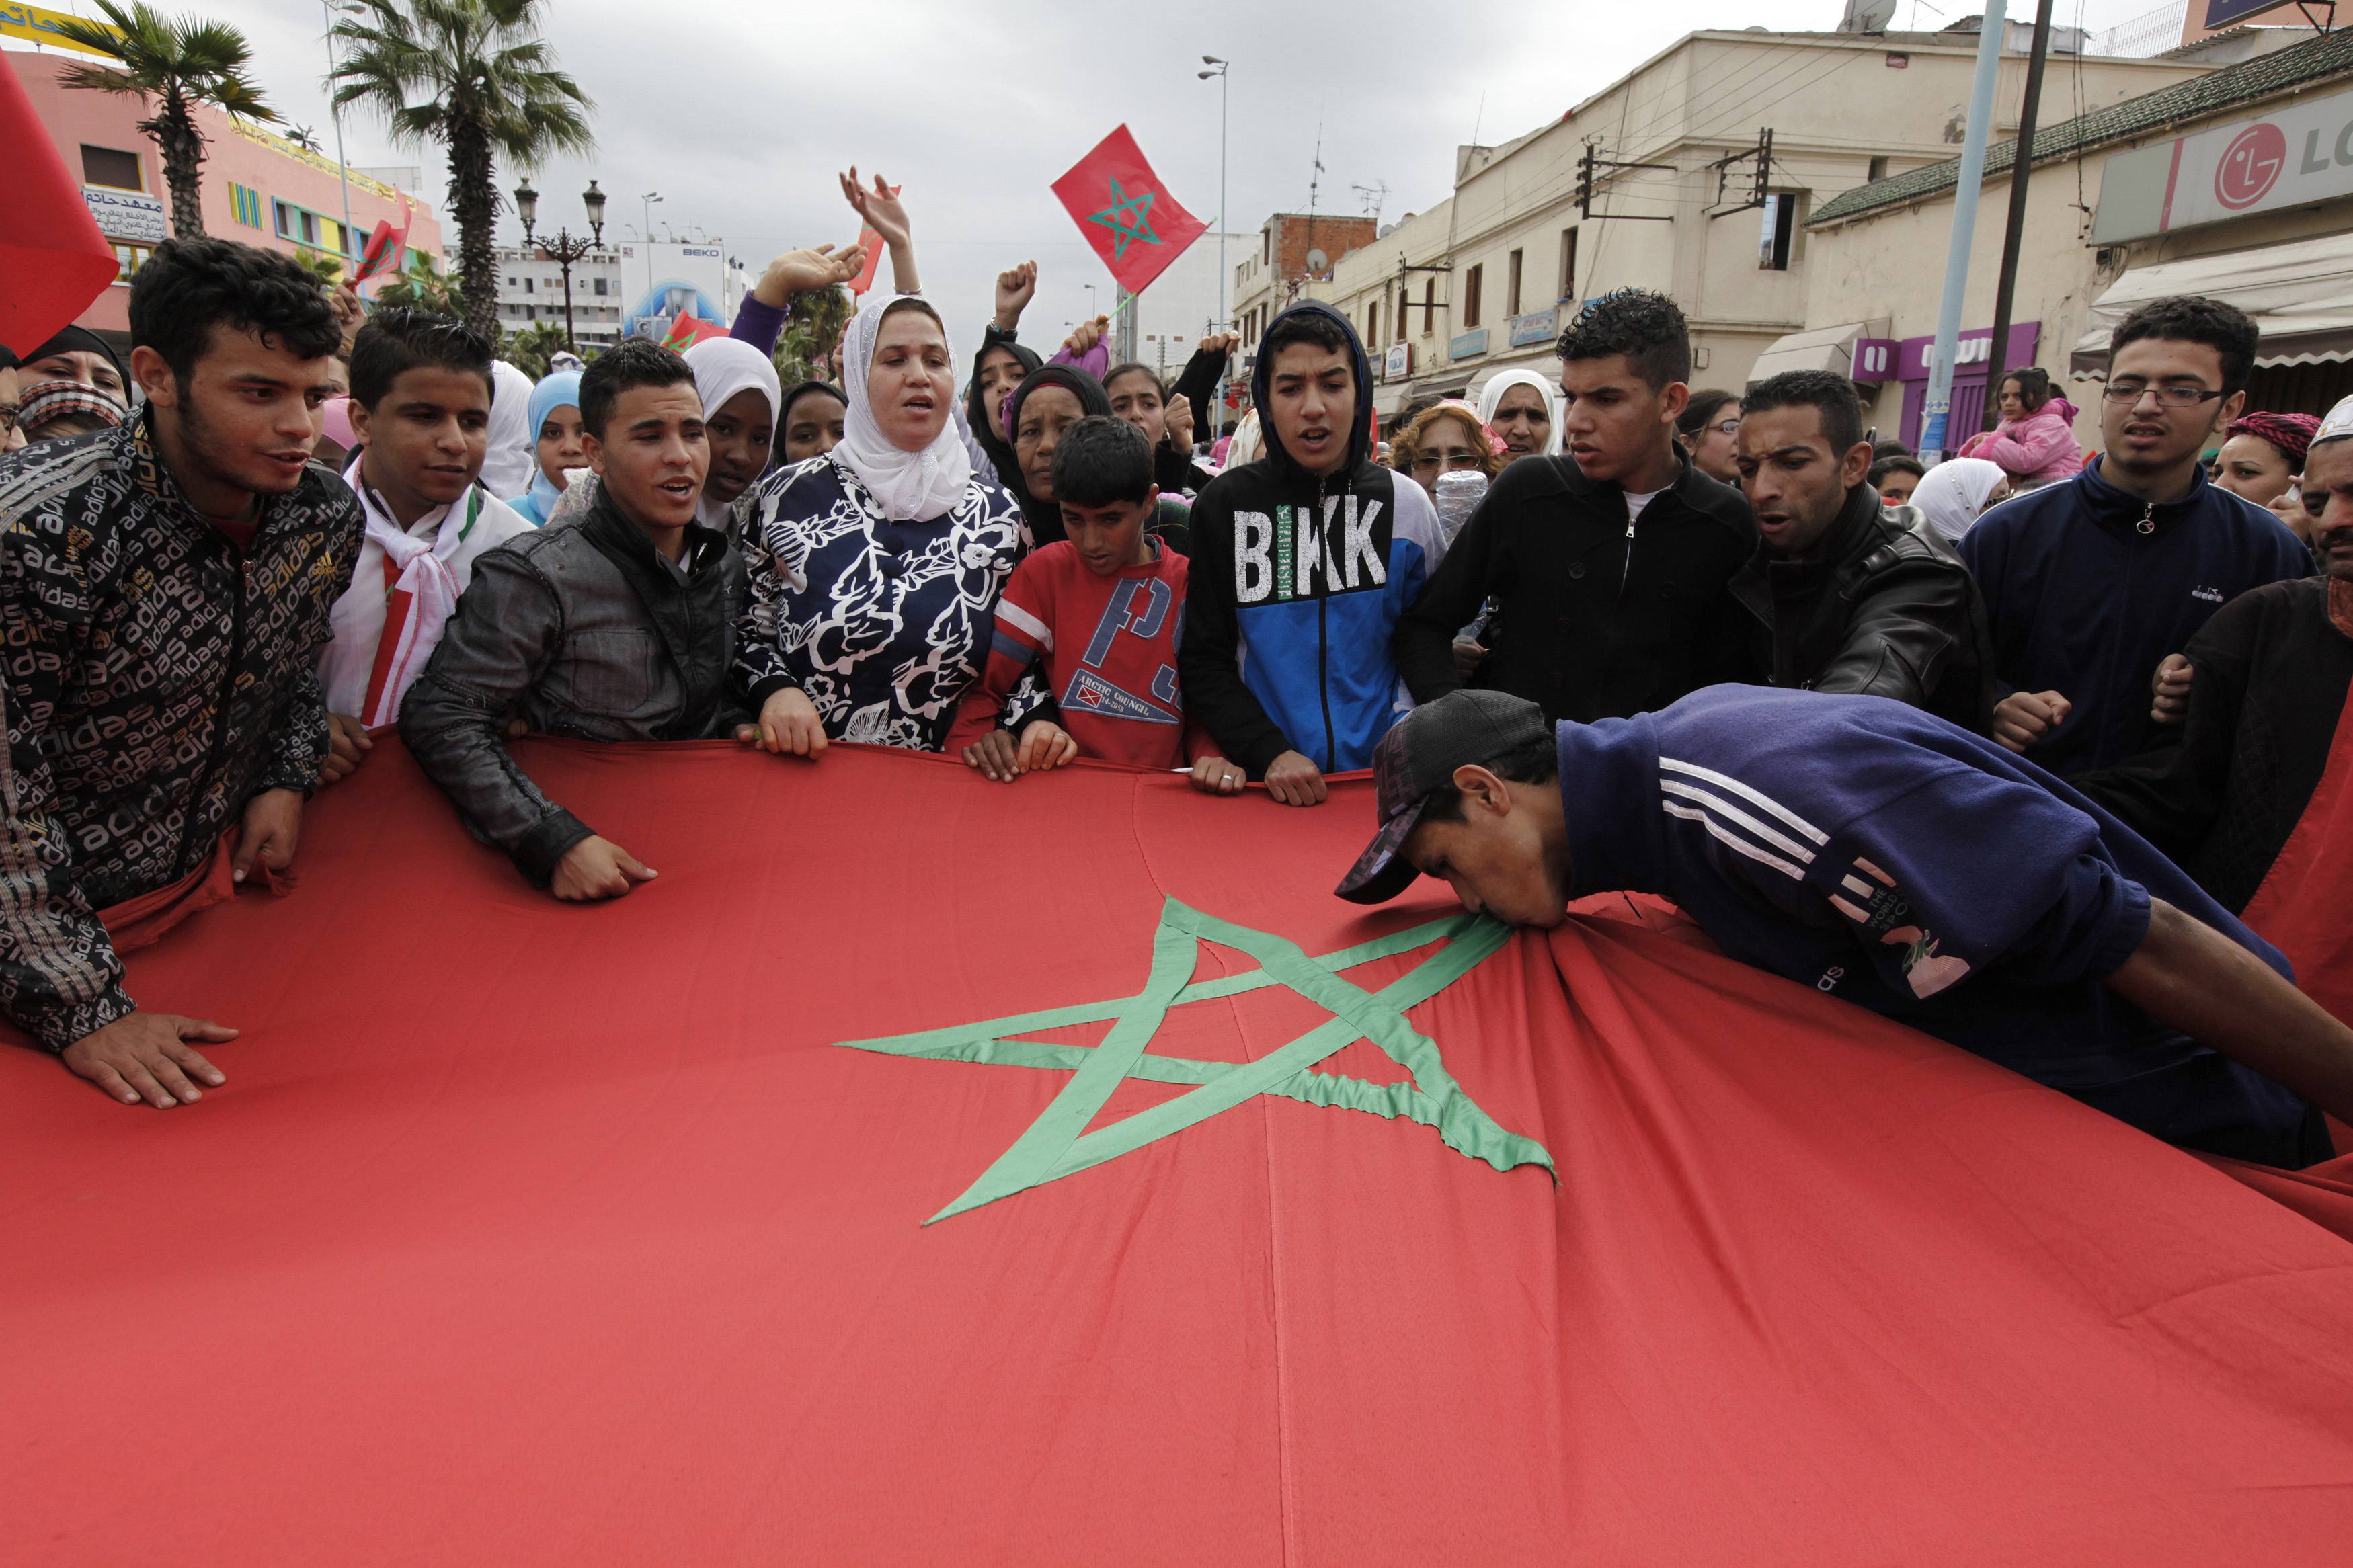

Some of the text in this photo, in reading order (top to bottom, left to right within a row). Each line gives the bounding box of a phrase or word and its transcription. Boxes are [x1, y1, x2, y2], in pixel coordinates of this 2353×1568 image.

[85, 192, 120, 206] حاتم
[120, 198, 162, 214] معهد
[682, 249, 719, 257] BEKO
[1078, 674, 1150, 716] ARCTIC COUNCIL
[124, 693, 203, 747] adidas
[1869, 887, 1888, 908] THE
[1867, 893, 1898, 928] WORLD
[1879, 901, 1910, 931] SPO
